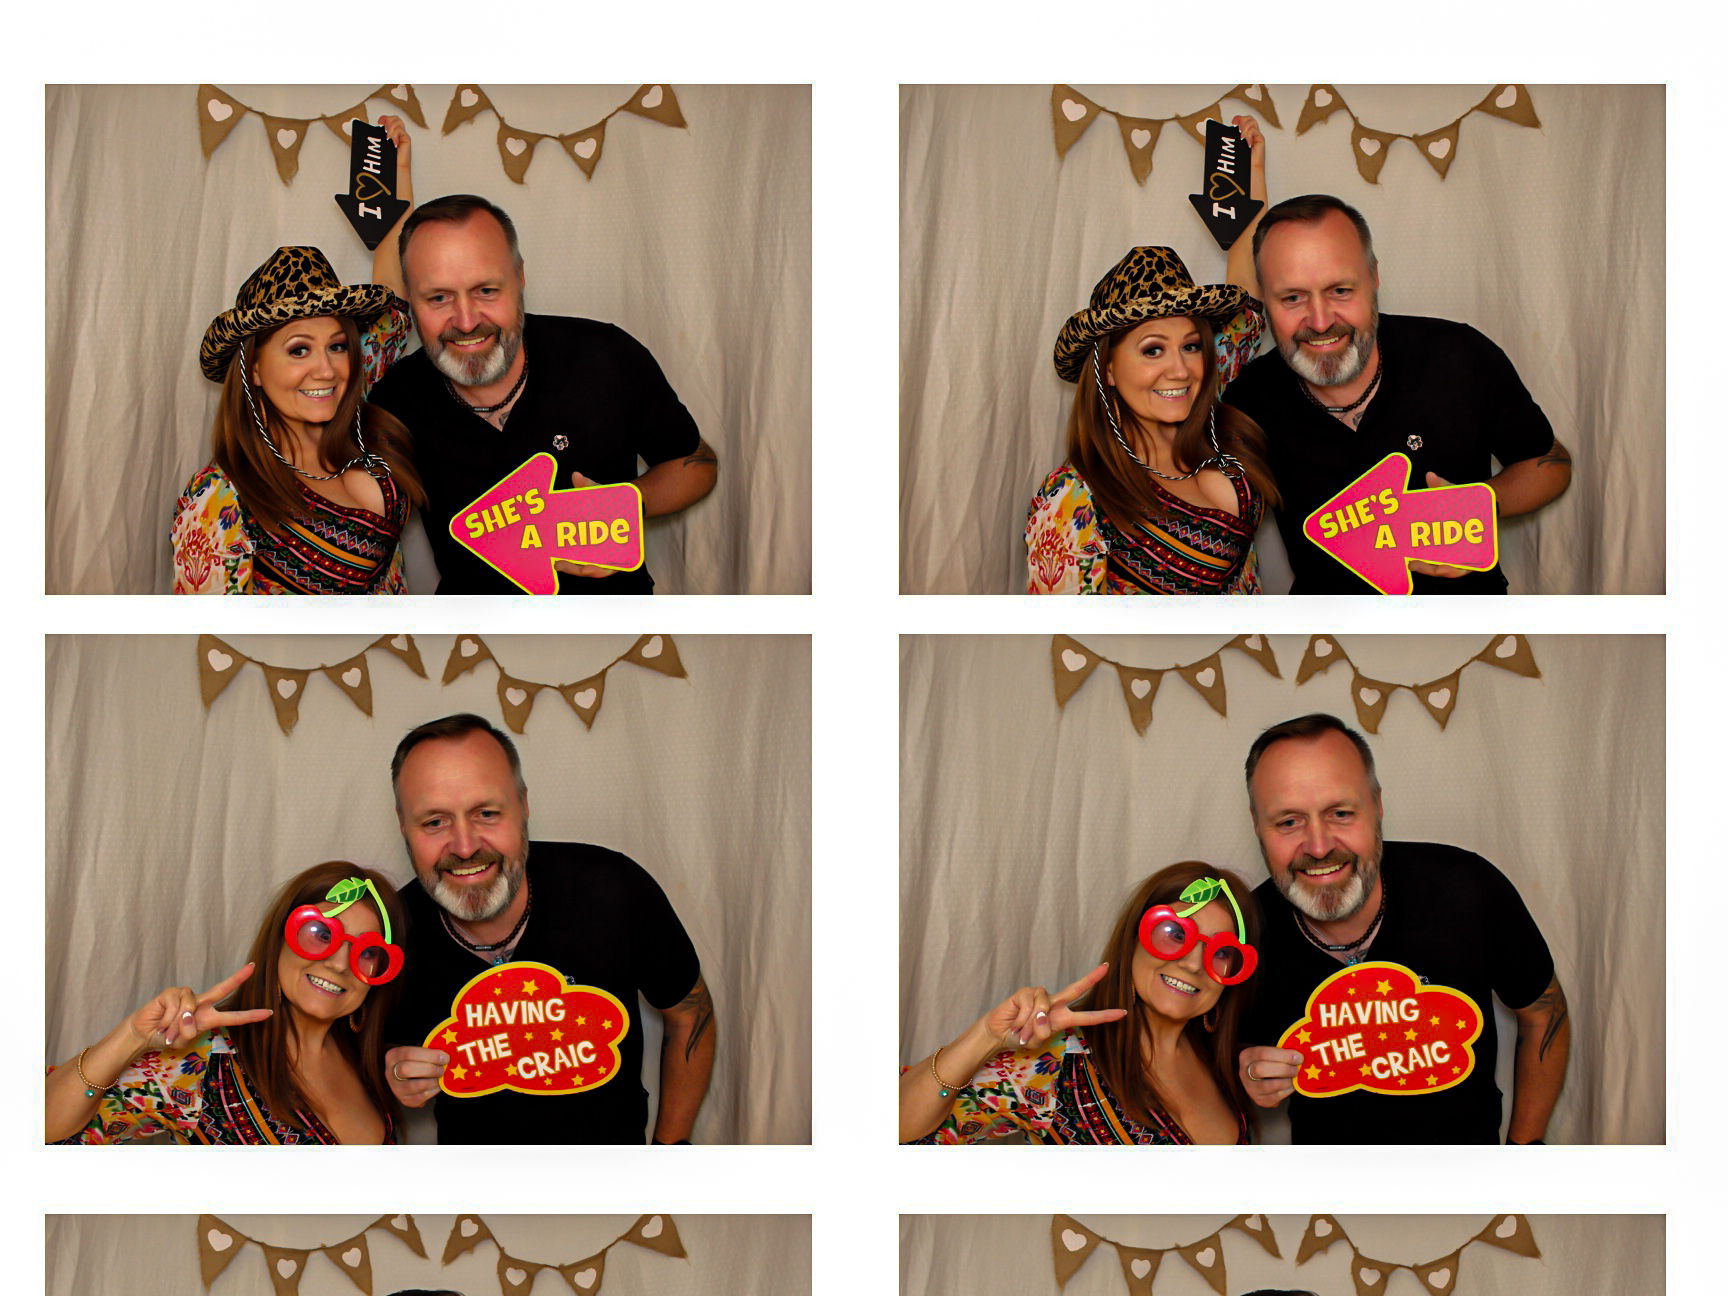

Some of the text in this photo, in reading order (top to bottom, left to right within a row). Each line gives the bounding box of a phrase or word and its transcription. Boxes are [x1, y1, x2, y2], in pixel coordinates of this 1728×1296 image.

[358, 136, 382, 220] I HIM
[1212, 136, 1236, 220] I HIM
[465, 488, 545, 539] SHE'S
[520, 524, 543, 549] A
[1319, 488, 1399, 539] SHE'S
[1374, 524, 1397, 549] A
[465, 998, 566, 1028] HAVING
[1319, 998, 1420, 1028] HAVING
[456, 1032, 597, 1080] THE CRAIC
[1310, 1032, 1451, 1080] THE CRAIC
